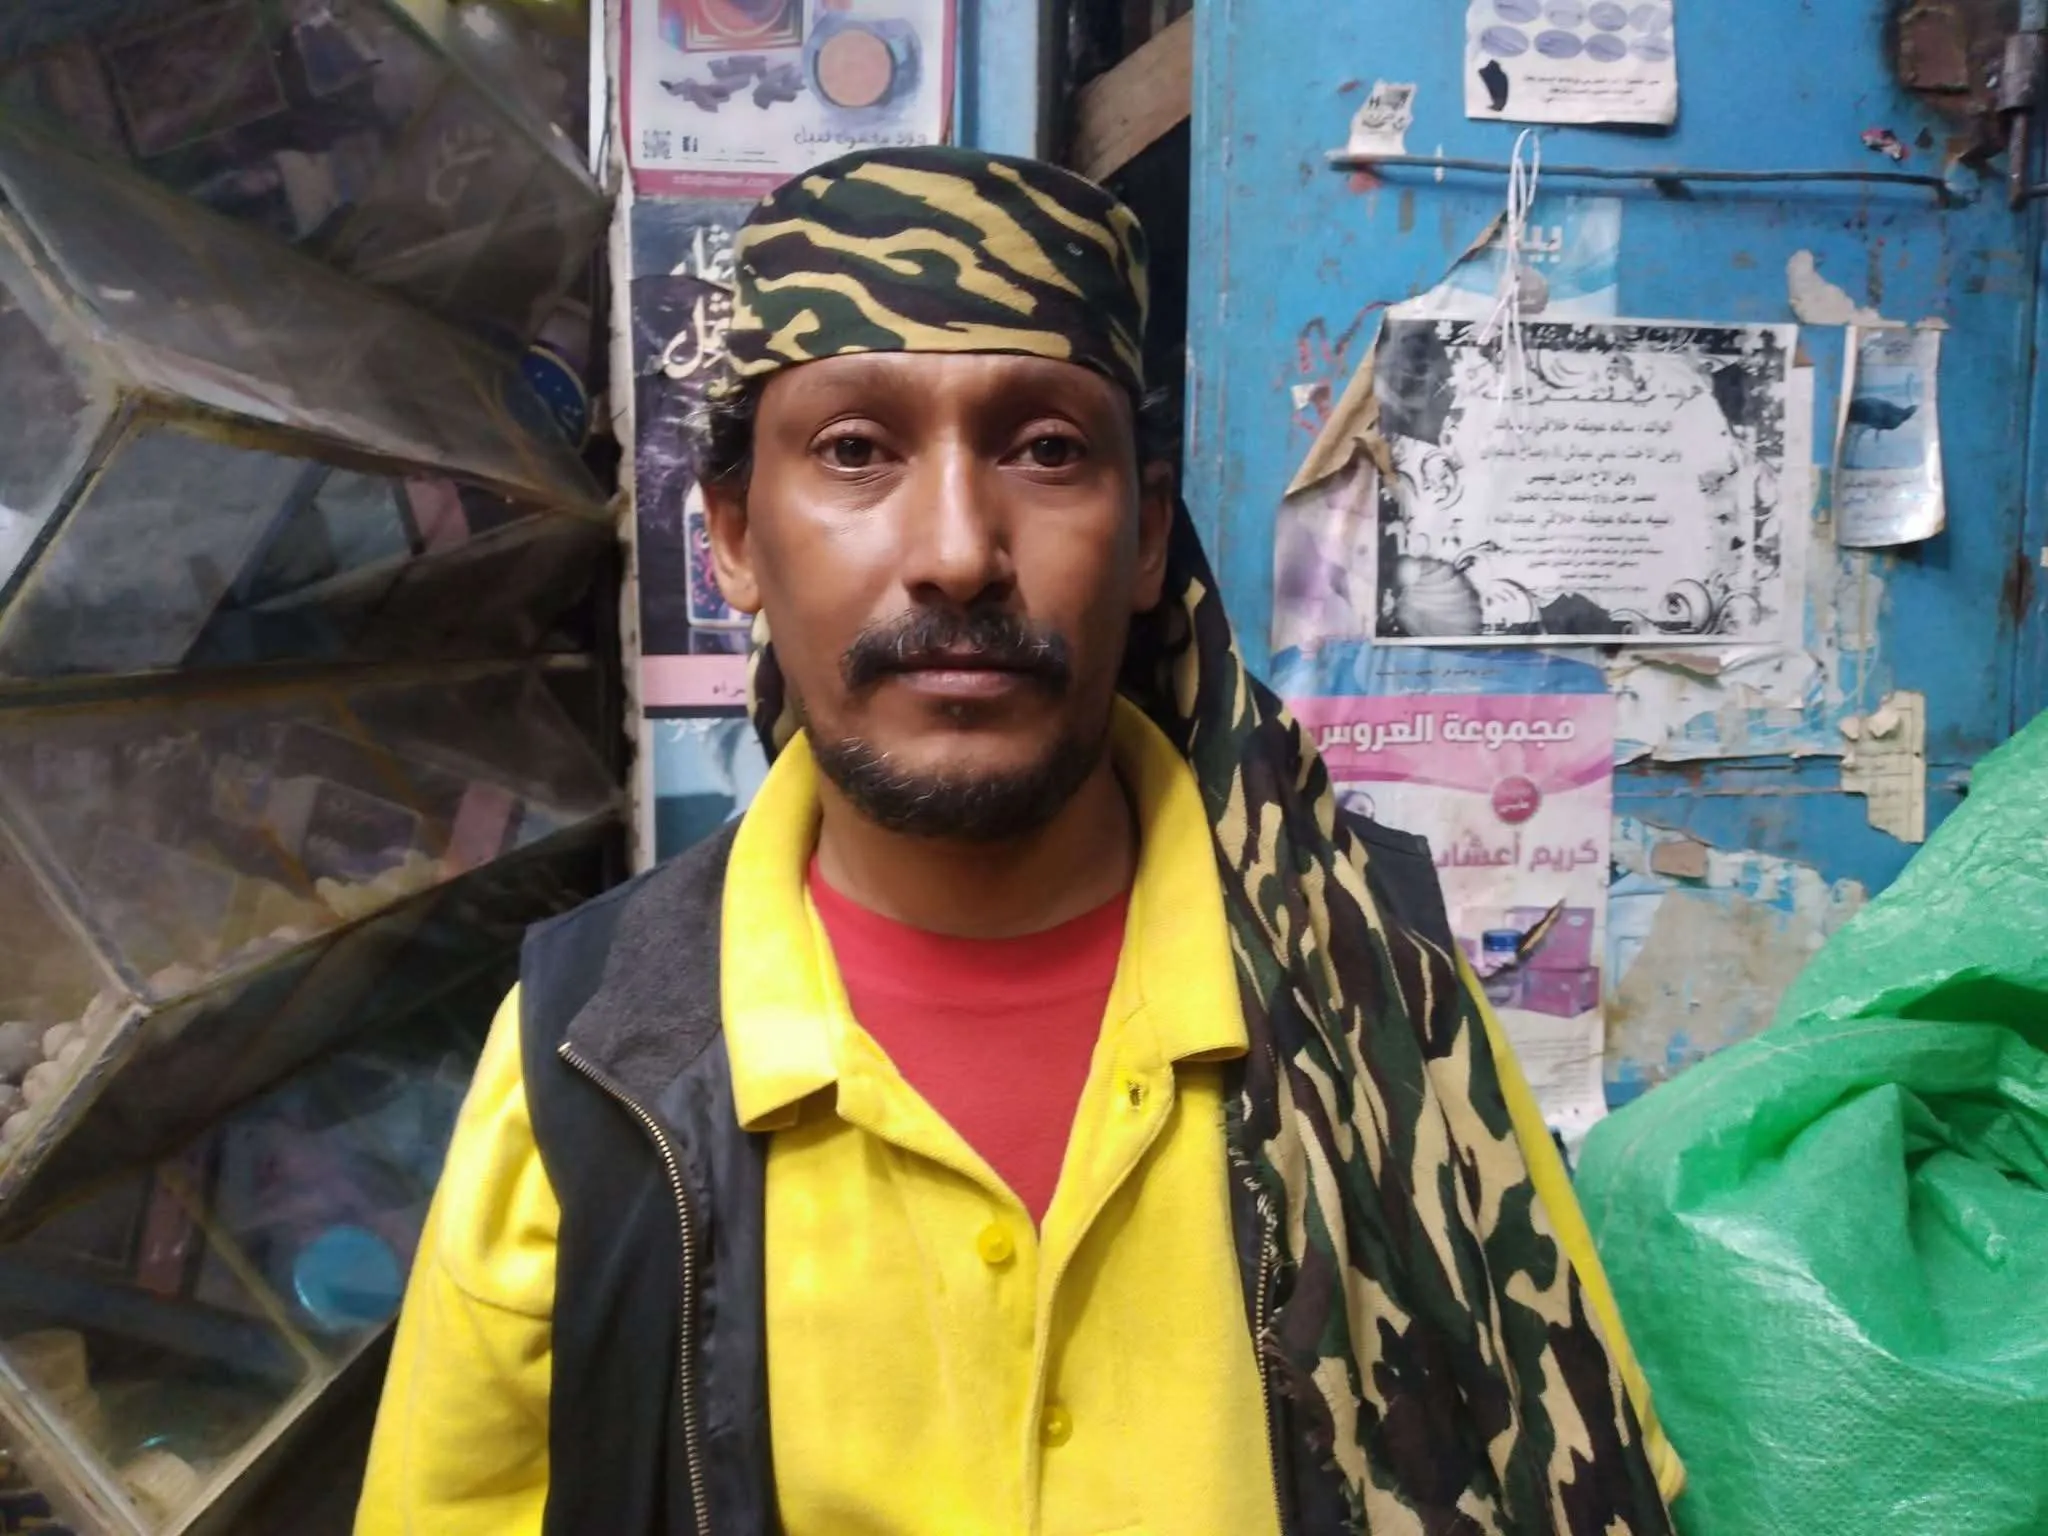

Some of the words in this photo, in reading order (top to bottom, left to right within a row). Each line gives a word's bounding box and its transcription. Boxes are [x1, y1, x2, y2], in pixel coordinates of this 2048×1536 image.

[1318, 713, 1433, 752] العروس
[1443, 713, 1576, 750] مجموعة
[1529, 838, 1599, 872] كريم
